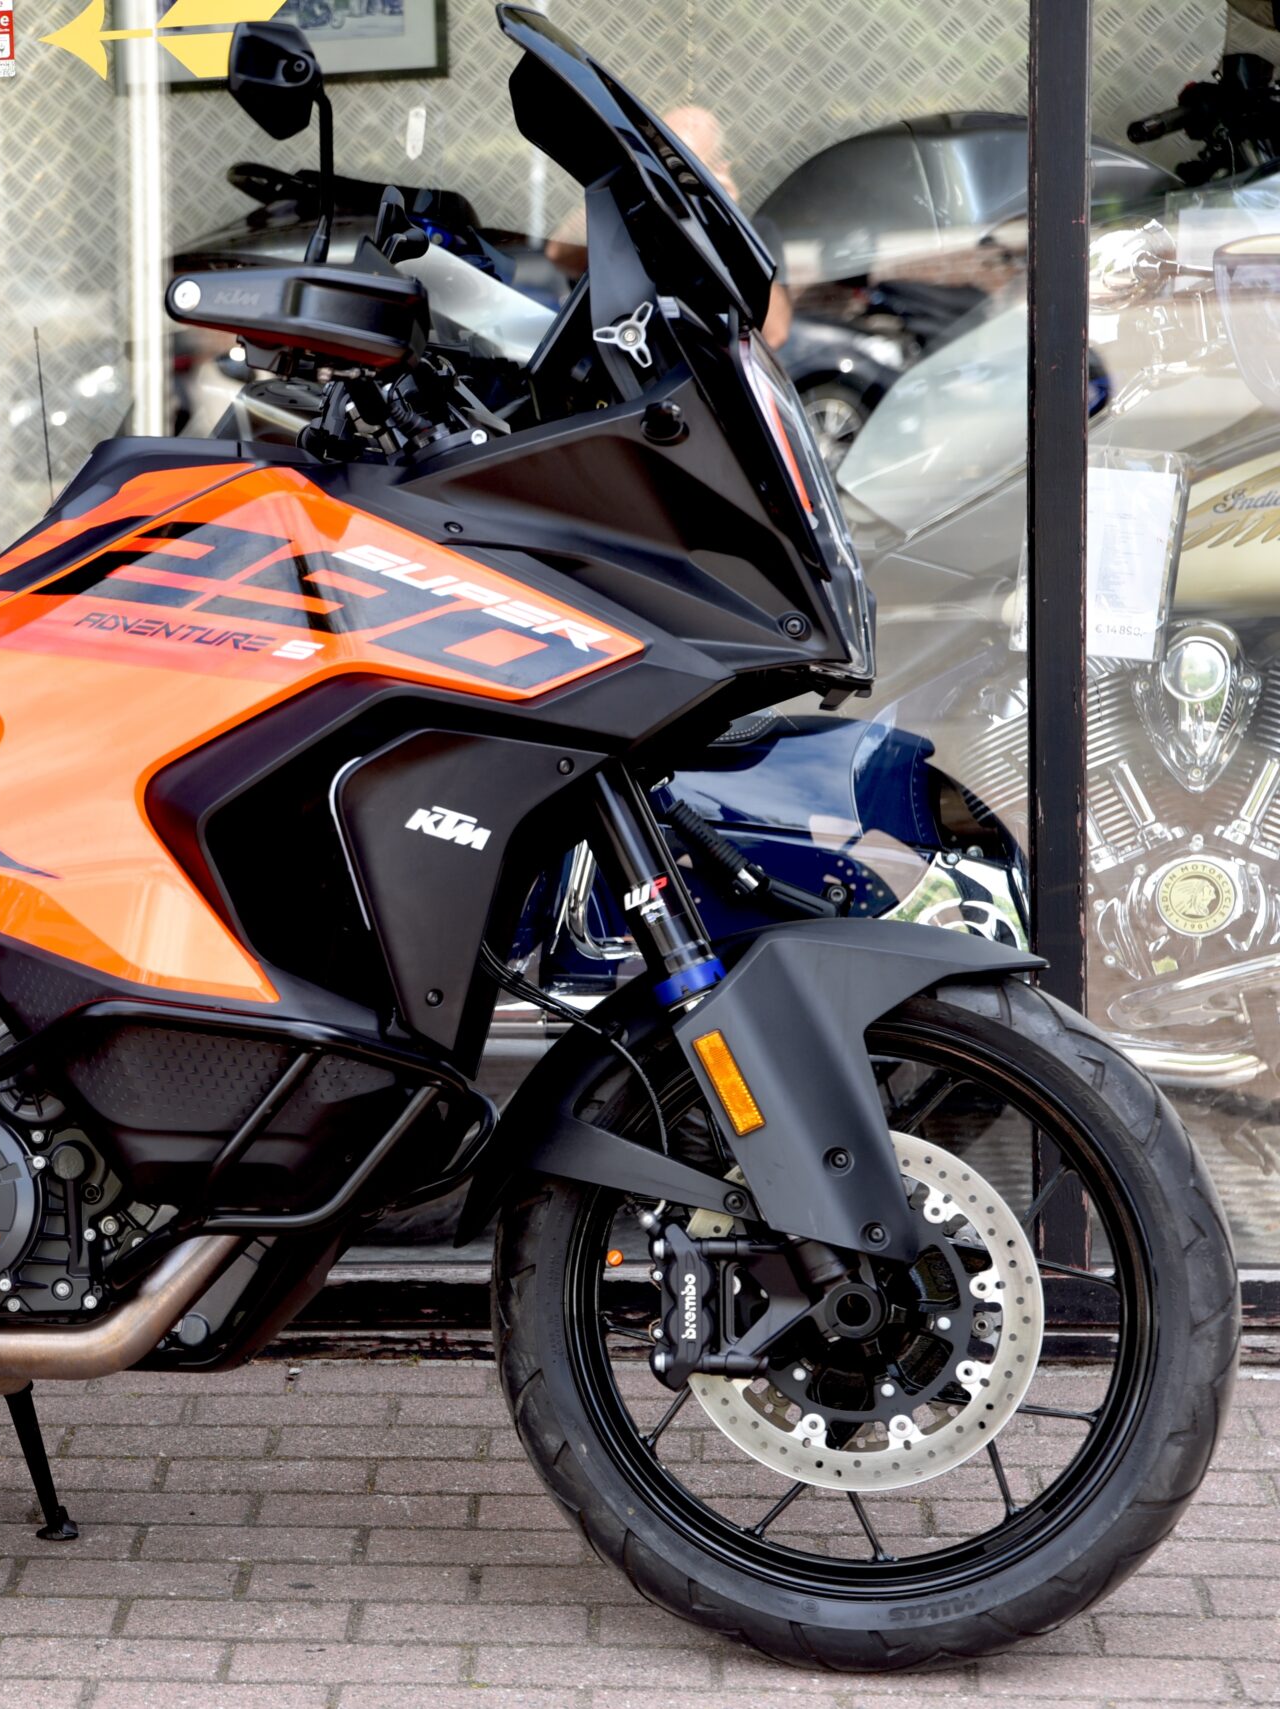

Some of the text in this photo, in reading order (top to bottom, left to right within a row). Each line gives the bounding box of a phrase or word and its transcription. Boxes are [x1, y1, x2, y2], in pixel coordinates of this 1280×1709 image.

[331, 544, 613, 653] SUPER
[74, 612, 326, 661] ADVENTURE S
[404, 805, 492, 851] KTM
[624, 875, 668, 911] WP
[681, 1273, 697, 1340] brembo
[887, 1588, 982, 1622] Mitas
